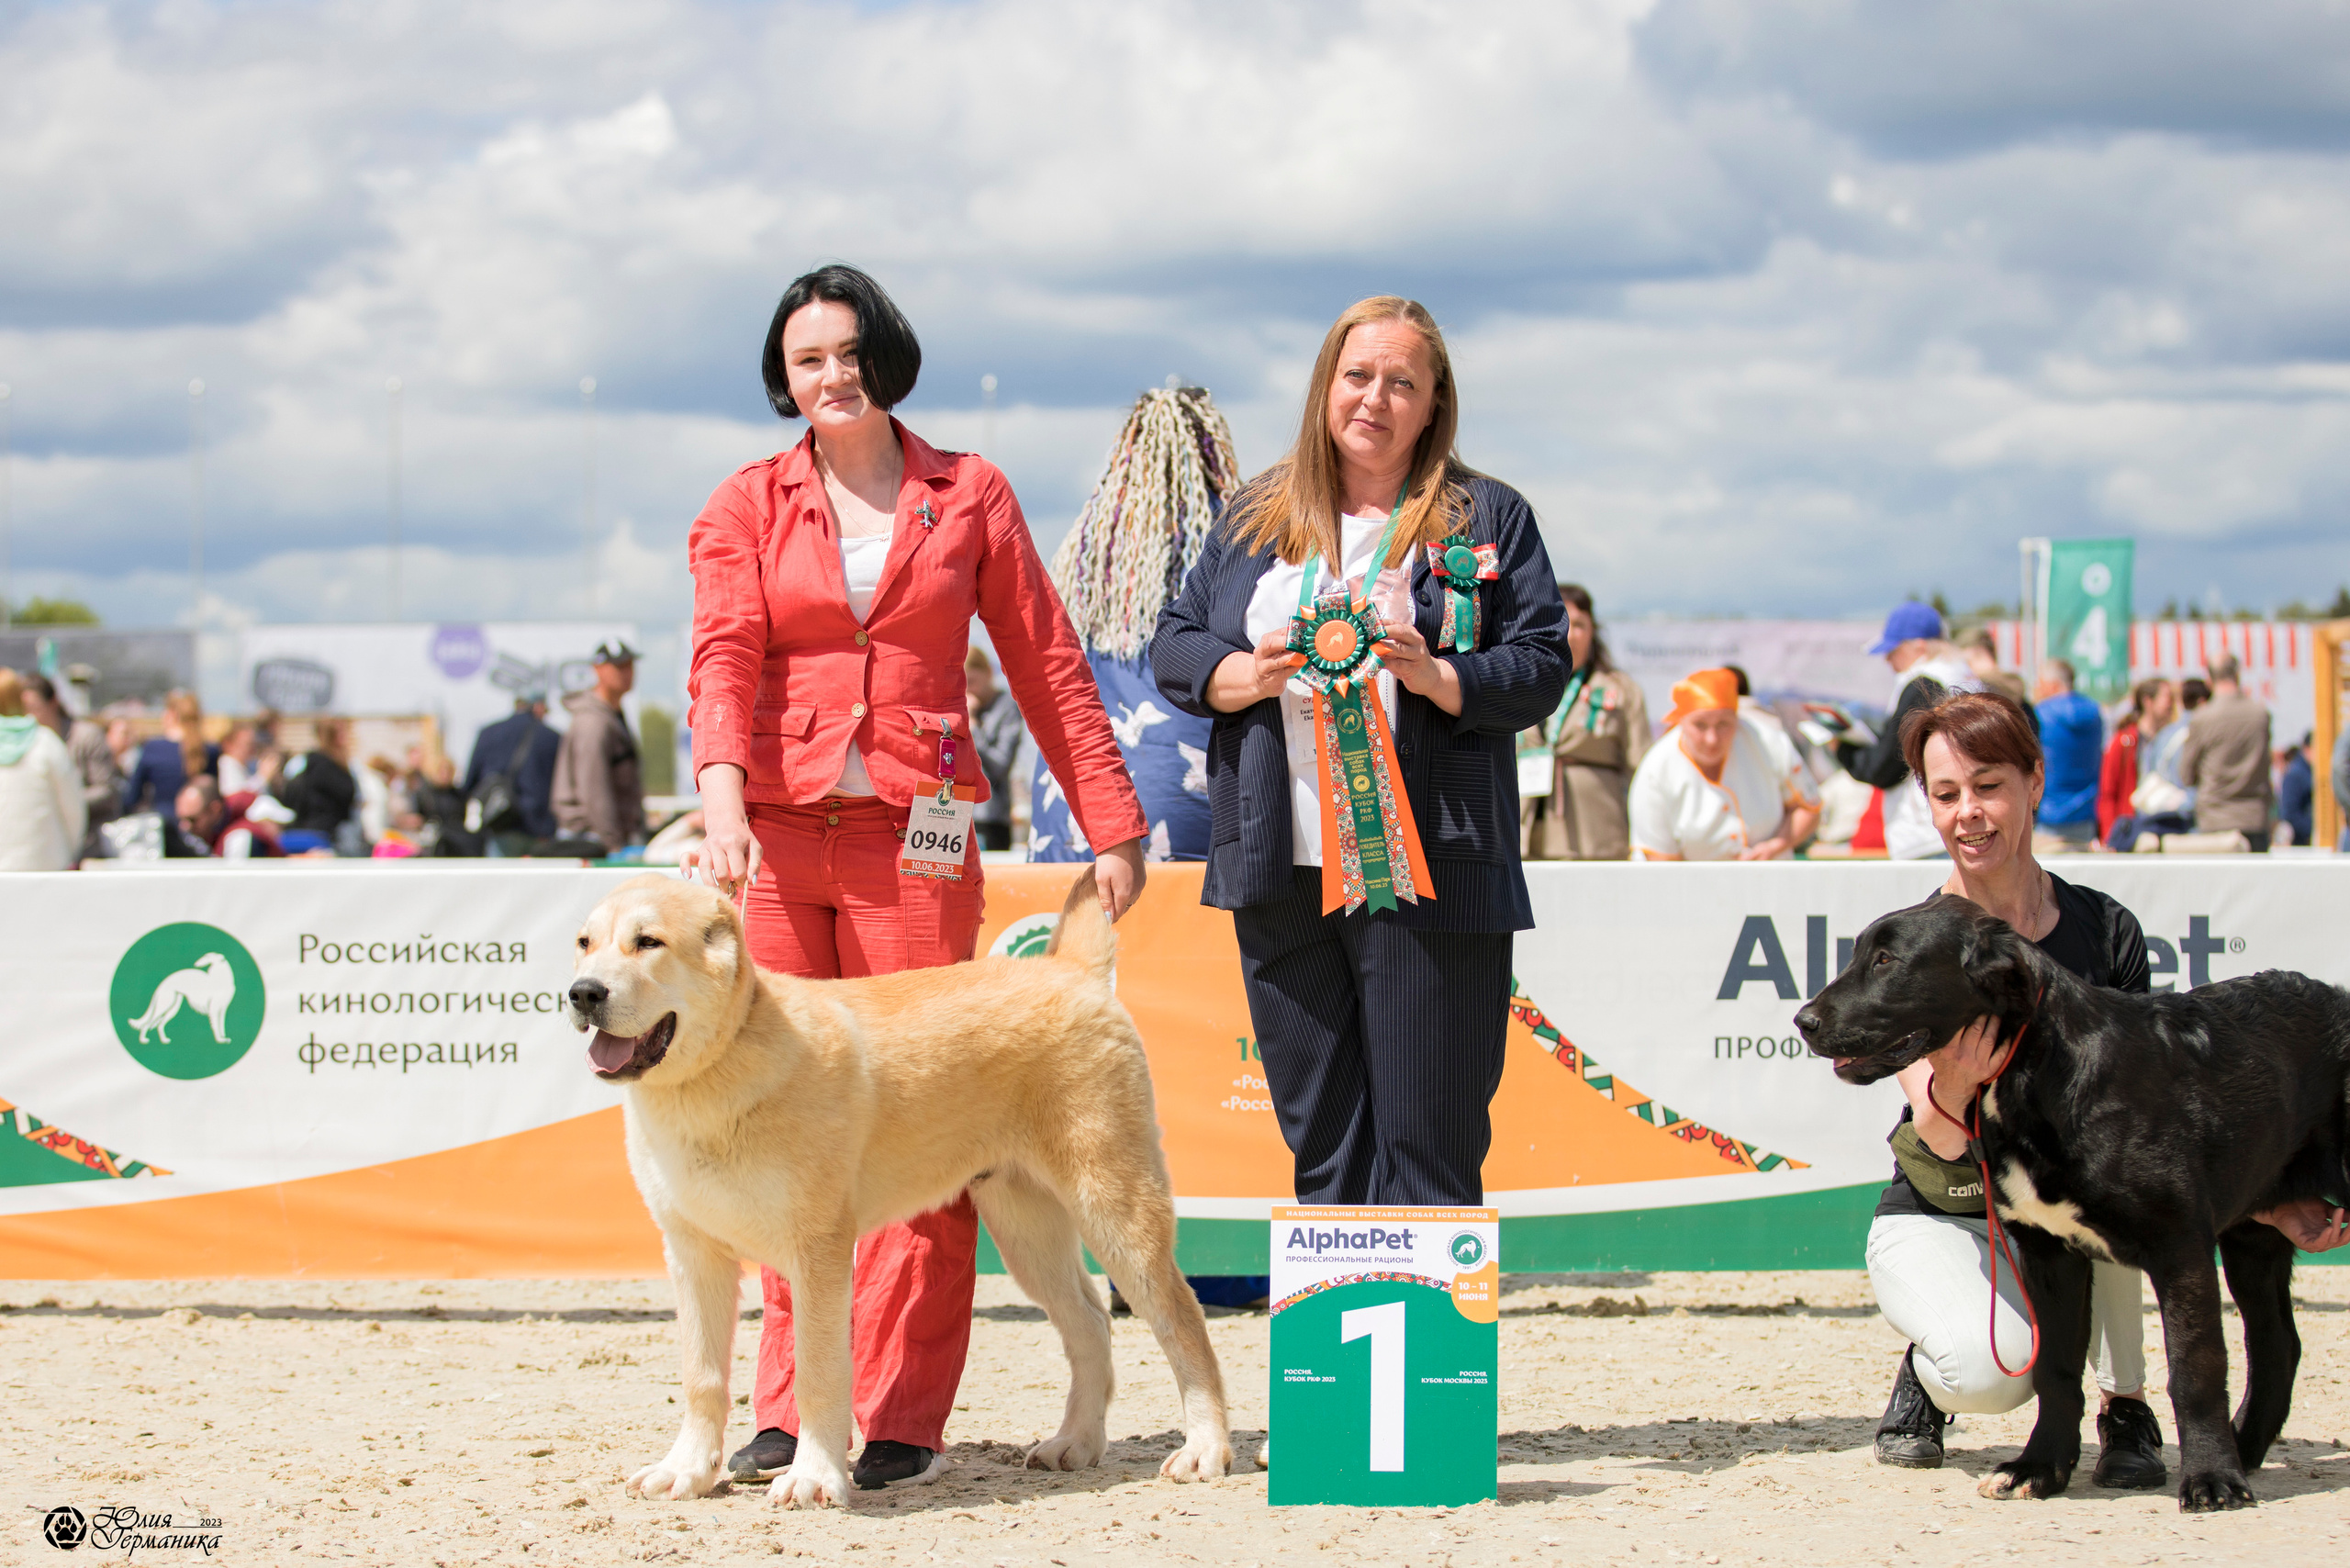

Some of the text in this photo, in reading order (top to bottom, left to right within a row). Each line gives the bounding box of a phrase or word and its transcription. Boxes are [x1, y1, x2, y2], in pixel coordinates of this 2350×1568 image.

[2071, 604, 2111, 669] 4
[1350, 791, 1377, 801] РОССИЯ
[1354, 799, 1375, 808] КУБОК
[928, 807, 956, 816] РОССИЯ
[1360, 813, 1375, 823] 2023
[911, 830, 962, 854] 0946
[1361, 850, 1384, 858] КЛАССА
[912, 861, 954, 873] 10.06.2023
[298, 933, 527, 964] Российская
[298, 1031, 519, 1074] федерация
[1285, 1210, 1357, 1218] НАЦИОНАЛЬНЫЕ
[1285, 1255, 1414, 1265] ПРОФЕССИОНАЛЬНЫЕ РАЦИОНЫ
[1458, 1282, 1470, 1291] 10
[1478, 1282, 1488, 1291] 11
[1458, 1293, 1488, 1301] ИЮНЯ
[1341, 1300, 1405, 1473] 1
